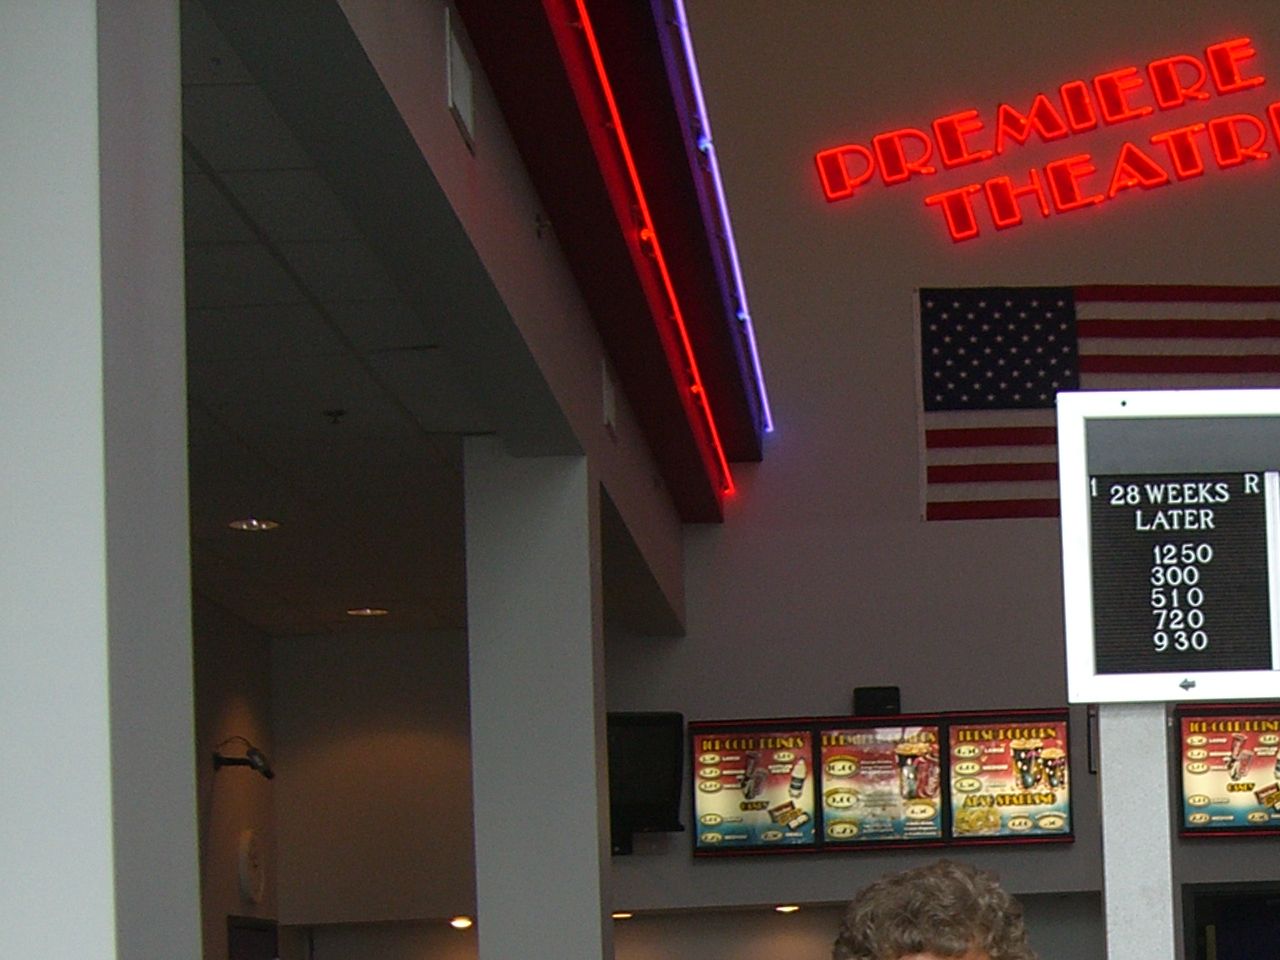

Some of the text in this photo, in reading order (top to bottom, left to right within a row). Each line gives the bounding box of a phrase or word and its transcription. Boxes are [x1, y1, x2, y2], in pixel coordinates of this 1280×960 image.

[815, 38, 1264, 201] PREMIERE
[1111, 485, 1140, 504] 28
[1145, 483, 1229, 503] WEEKS
[1245, 474, 1259, 493] R
[1136, 509, 1214, 530] LATER
[1154, 544, 1212, 564] 1250
[1151, 566, 1199, 585] 300
[1152, 588, 1203, 607] 510
[1153, 609, 1203, 629] 720
[1154, 631, 1207, 651] 930
